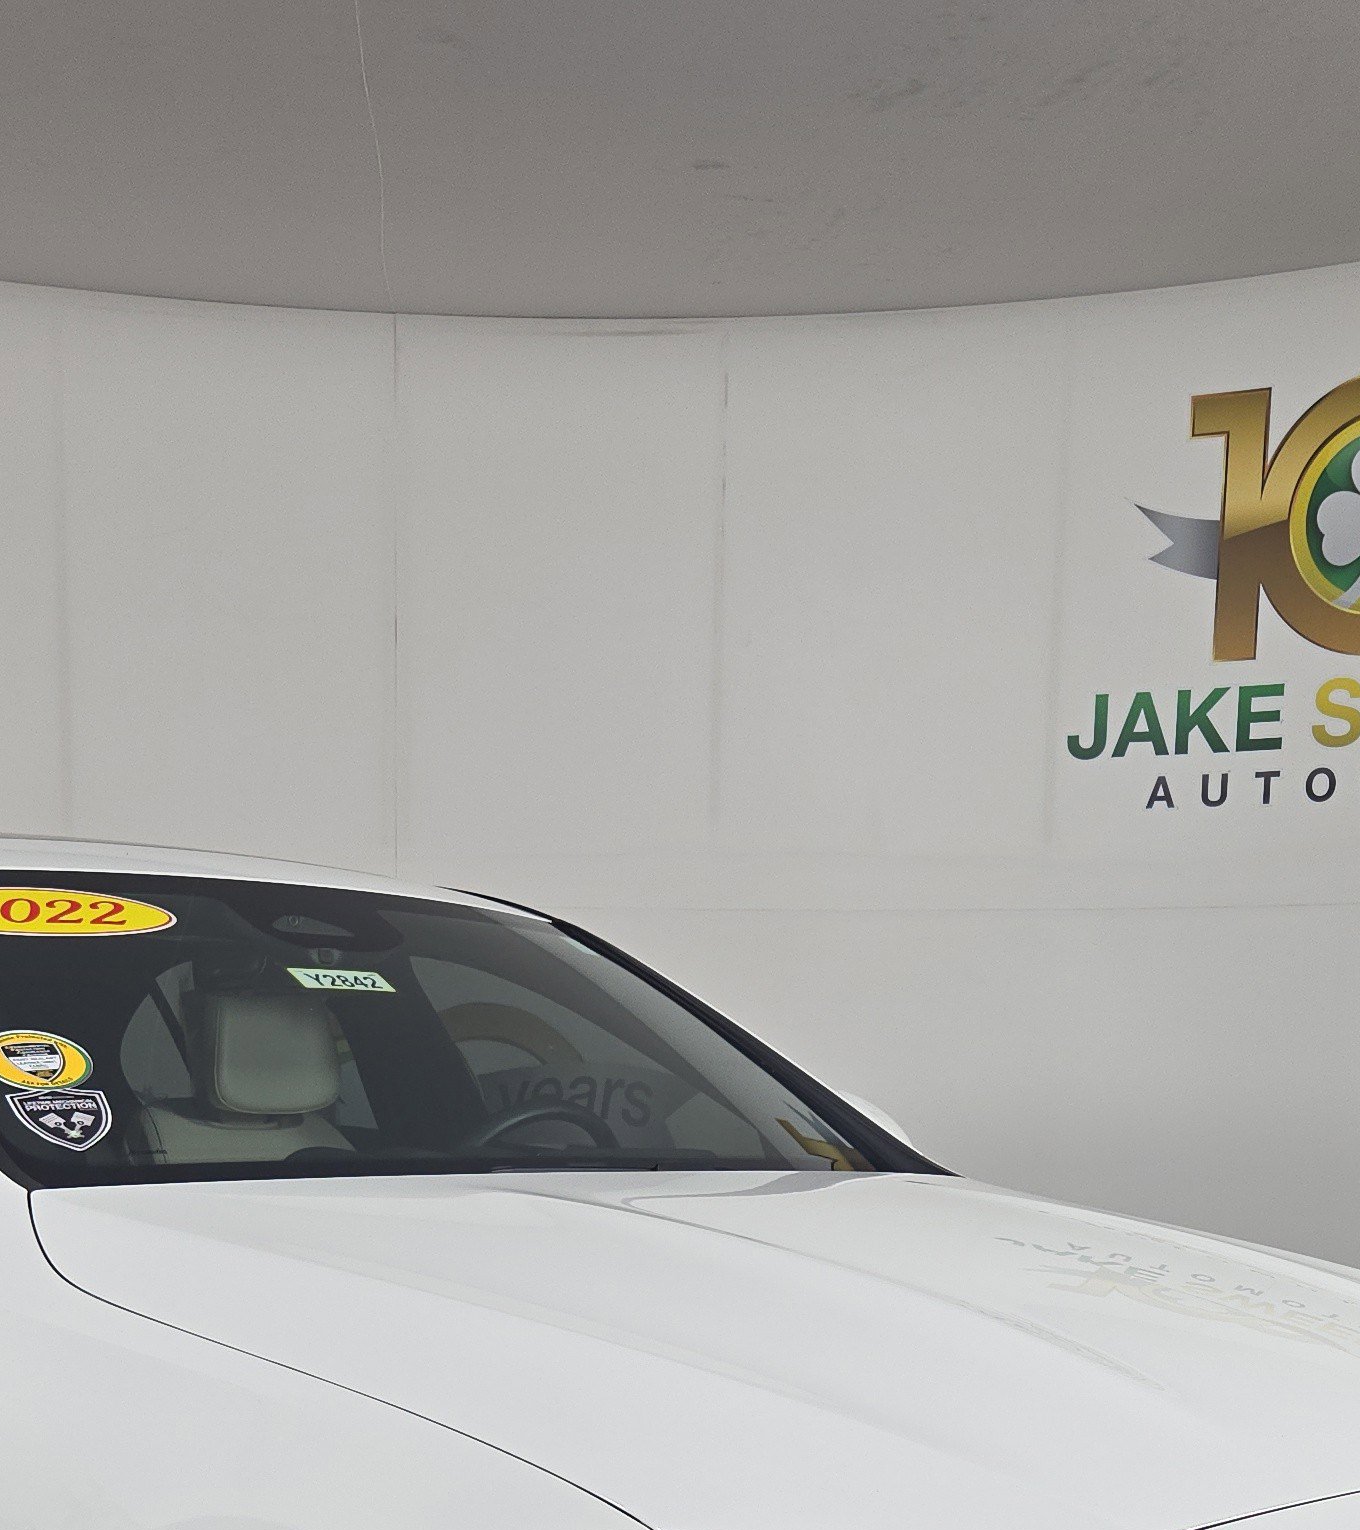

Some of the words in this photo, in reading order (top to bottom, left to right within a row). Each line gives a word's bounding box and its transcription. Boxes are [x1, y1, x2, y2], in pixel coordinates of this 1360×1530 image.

[1067, 683, 1285, 761] JAKE
[303, 973, 383, 989] Y2842
[25, 1102, 97, 1111] PROTECTION
